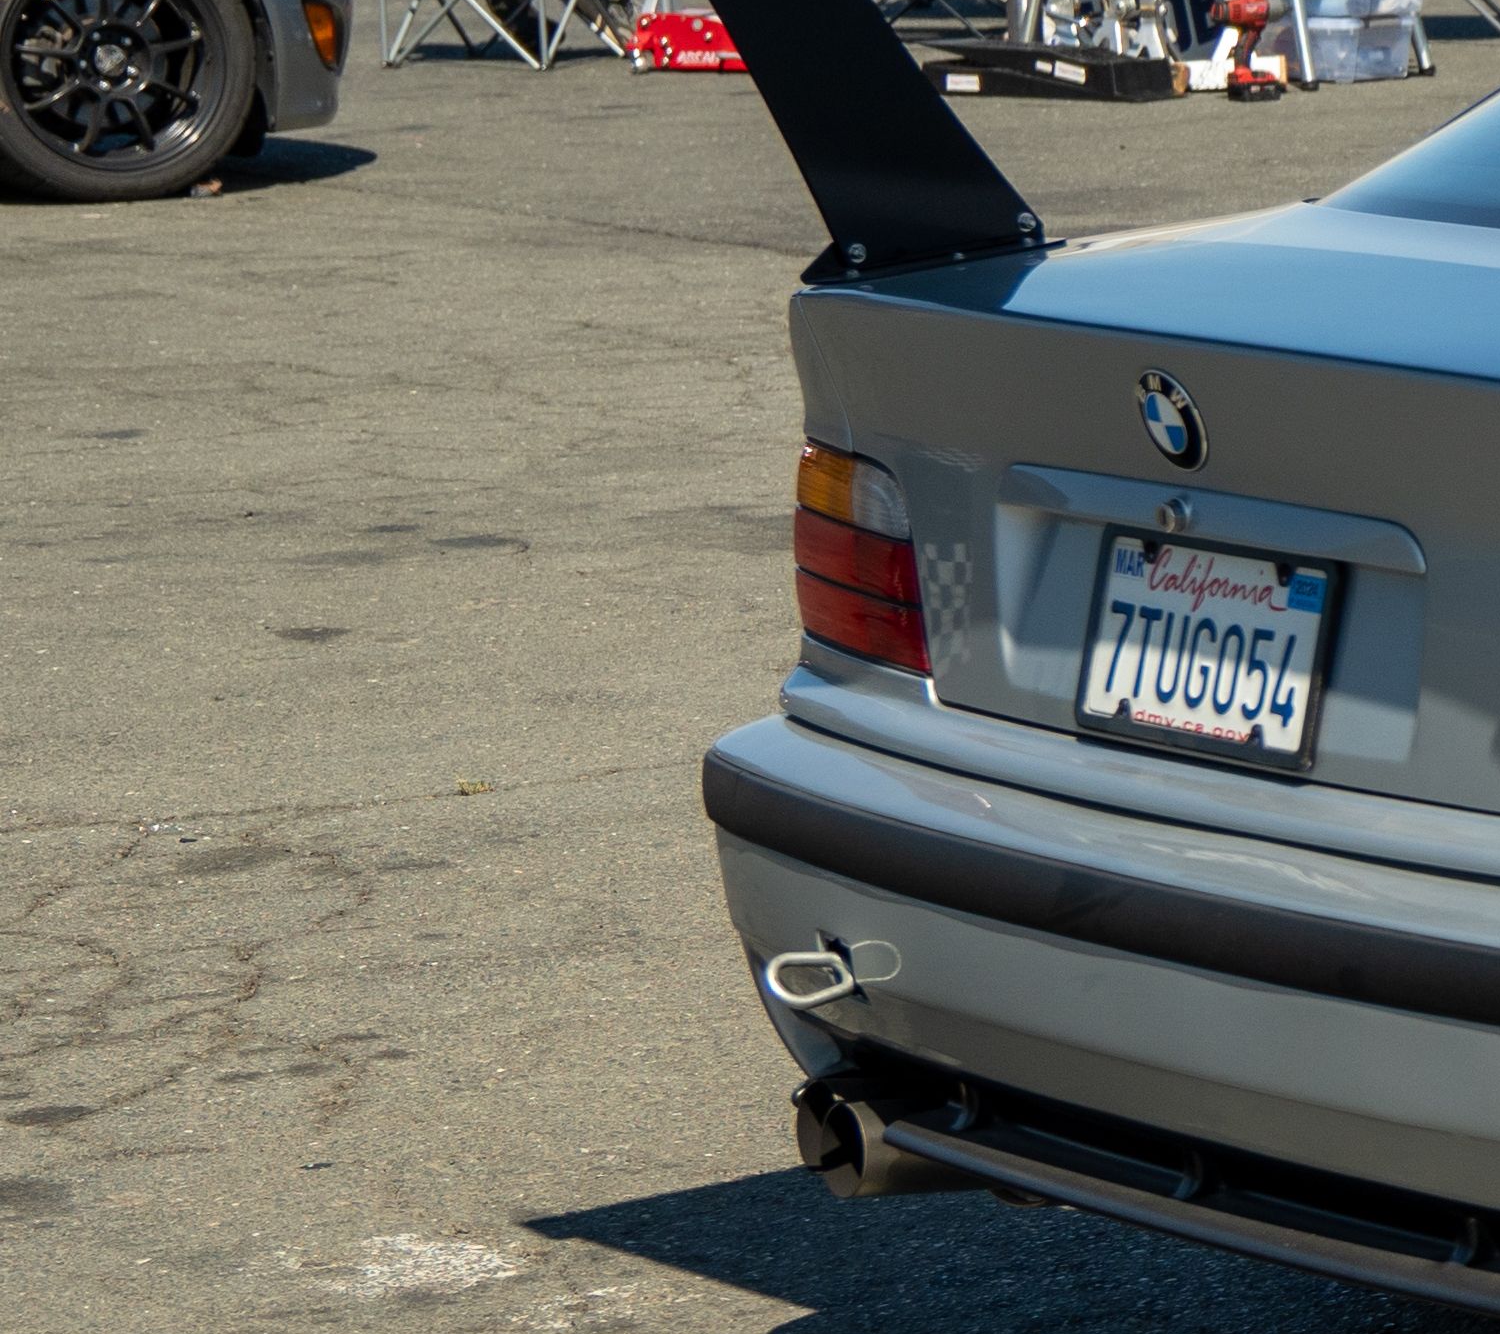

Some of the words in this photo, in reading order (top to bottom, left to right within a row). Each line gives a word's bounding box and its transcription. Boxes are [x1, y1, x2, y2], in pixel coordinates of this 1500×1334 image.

[1135, 374, 1189, 409] BMW
[1114, 548, 1145, 578] MAR
[1149, 548, 1288, 612] California
[1105, 599, 1298, 729] 7TUG054
[1134, 708, 1250, 743] dmv.ca.gov
